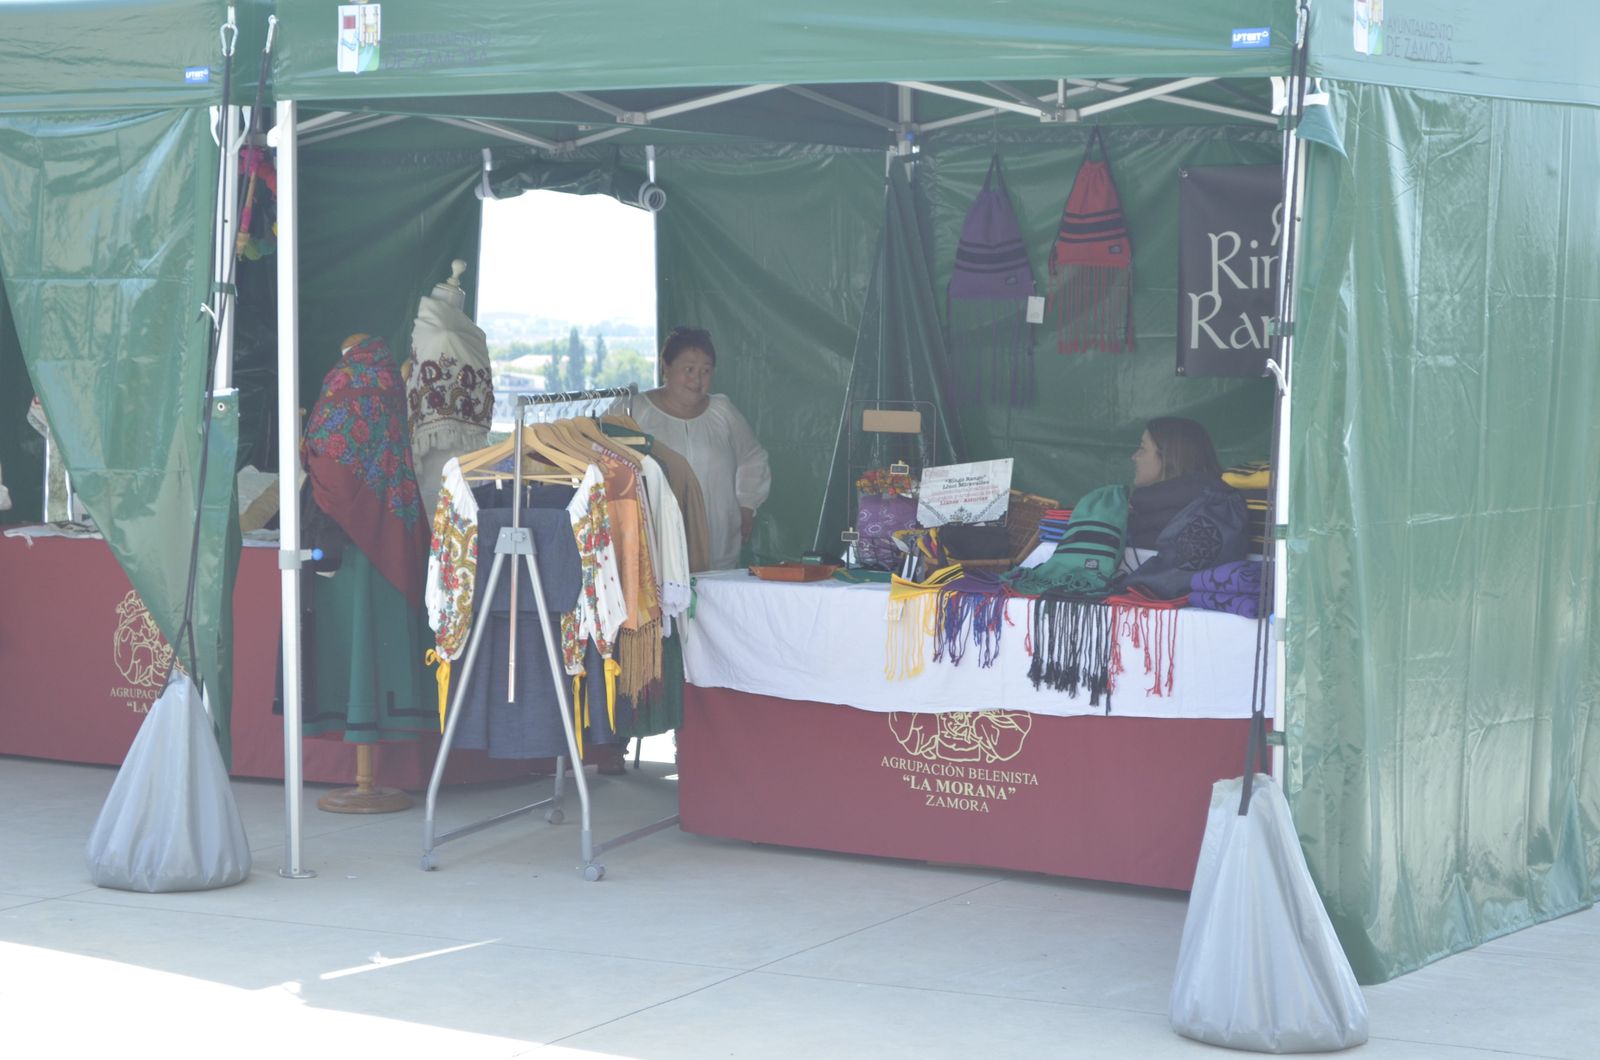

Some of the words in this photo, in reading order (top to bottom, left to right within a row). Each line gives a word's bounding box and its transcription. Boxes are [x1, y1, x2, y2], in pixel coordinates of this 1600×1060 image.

[1386, 34, 1401, 58] DE
[1403, 37, 1454, 64] ZAMORA
[880, 755, 966, 778] AGRUPACIÓN
[968, 767, 1040, 786] BELENISTA
[925, 794, 991, 814] ZAMORA
